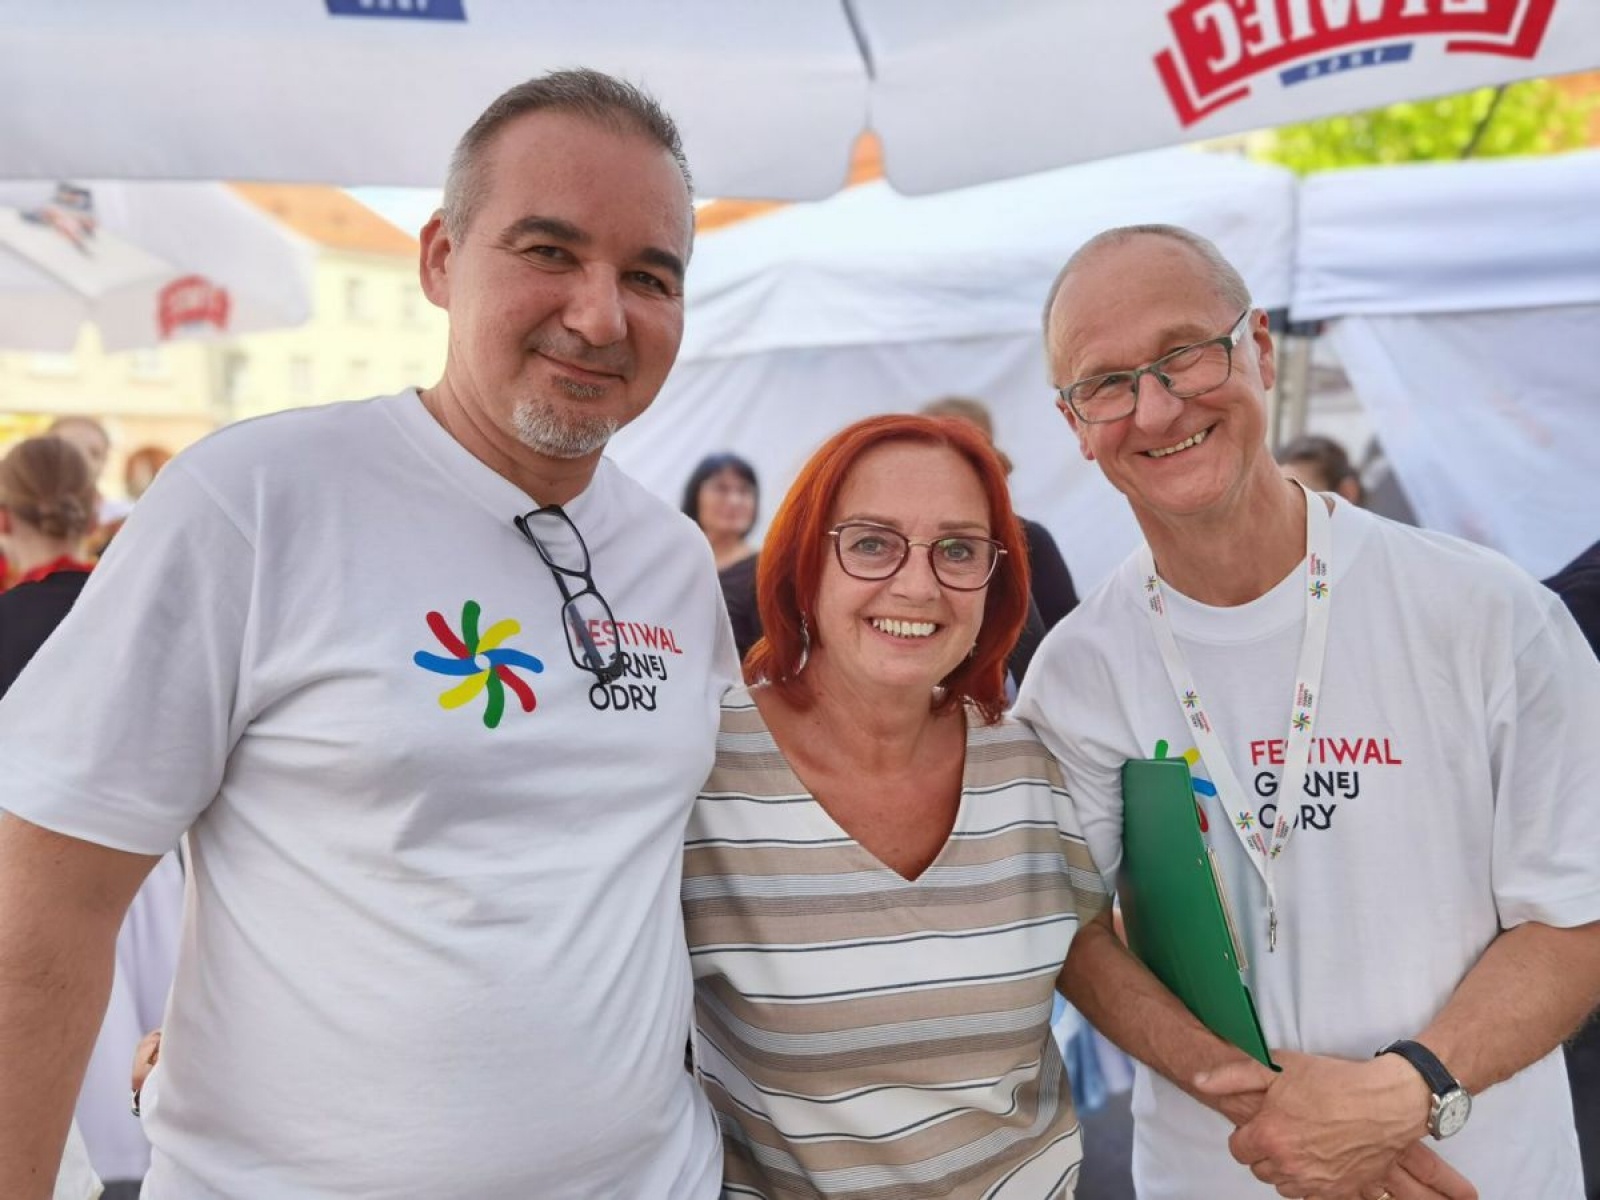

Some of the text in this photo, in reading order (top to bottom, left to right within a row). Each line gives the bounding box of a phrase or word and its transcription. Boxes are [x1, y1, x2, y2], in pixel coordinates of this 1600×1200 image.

[582, 651, 667, 680] RNEJ
[588, 683, 657, 711] ODRY
[1250, 737, 1402, 766] FEIWAL
[1254, 770, 1360, 799] GNEJ
[1258, 803, 1337, 830] ORY
